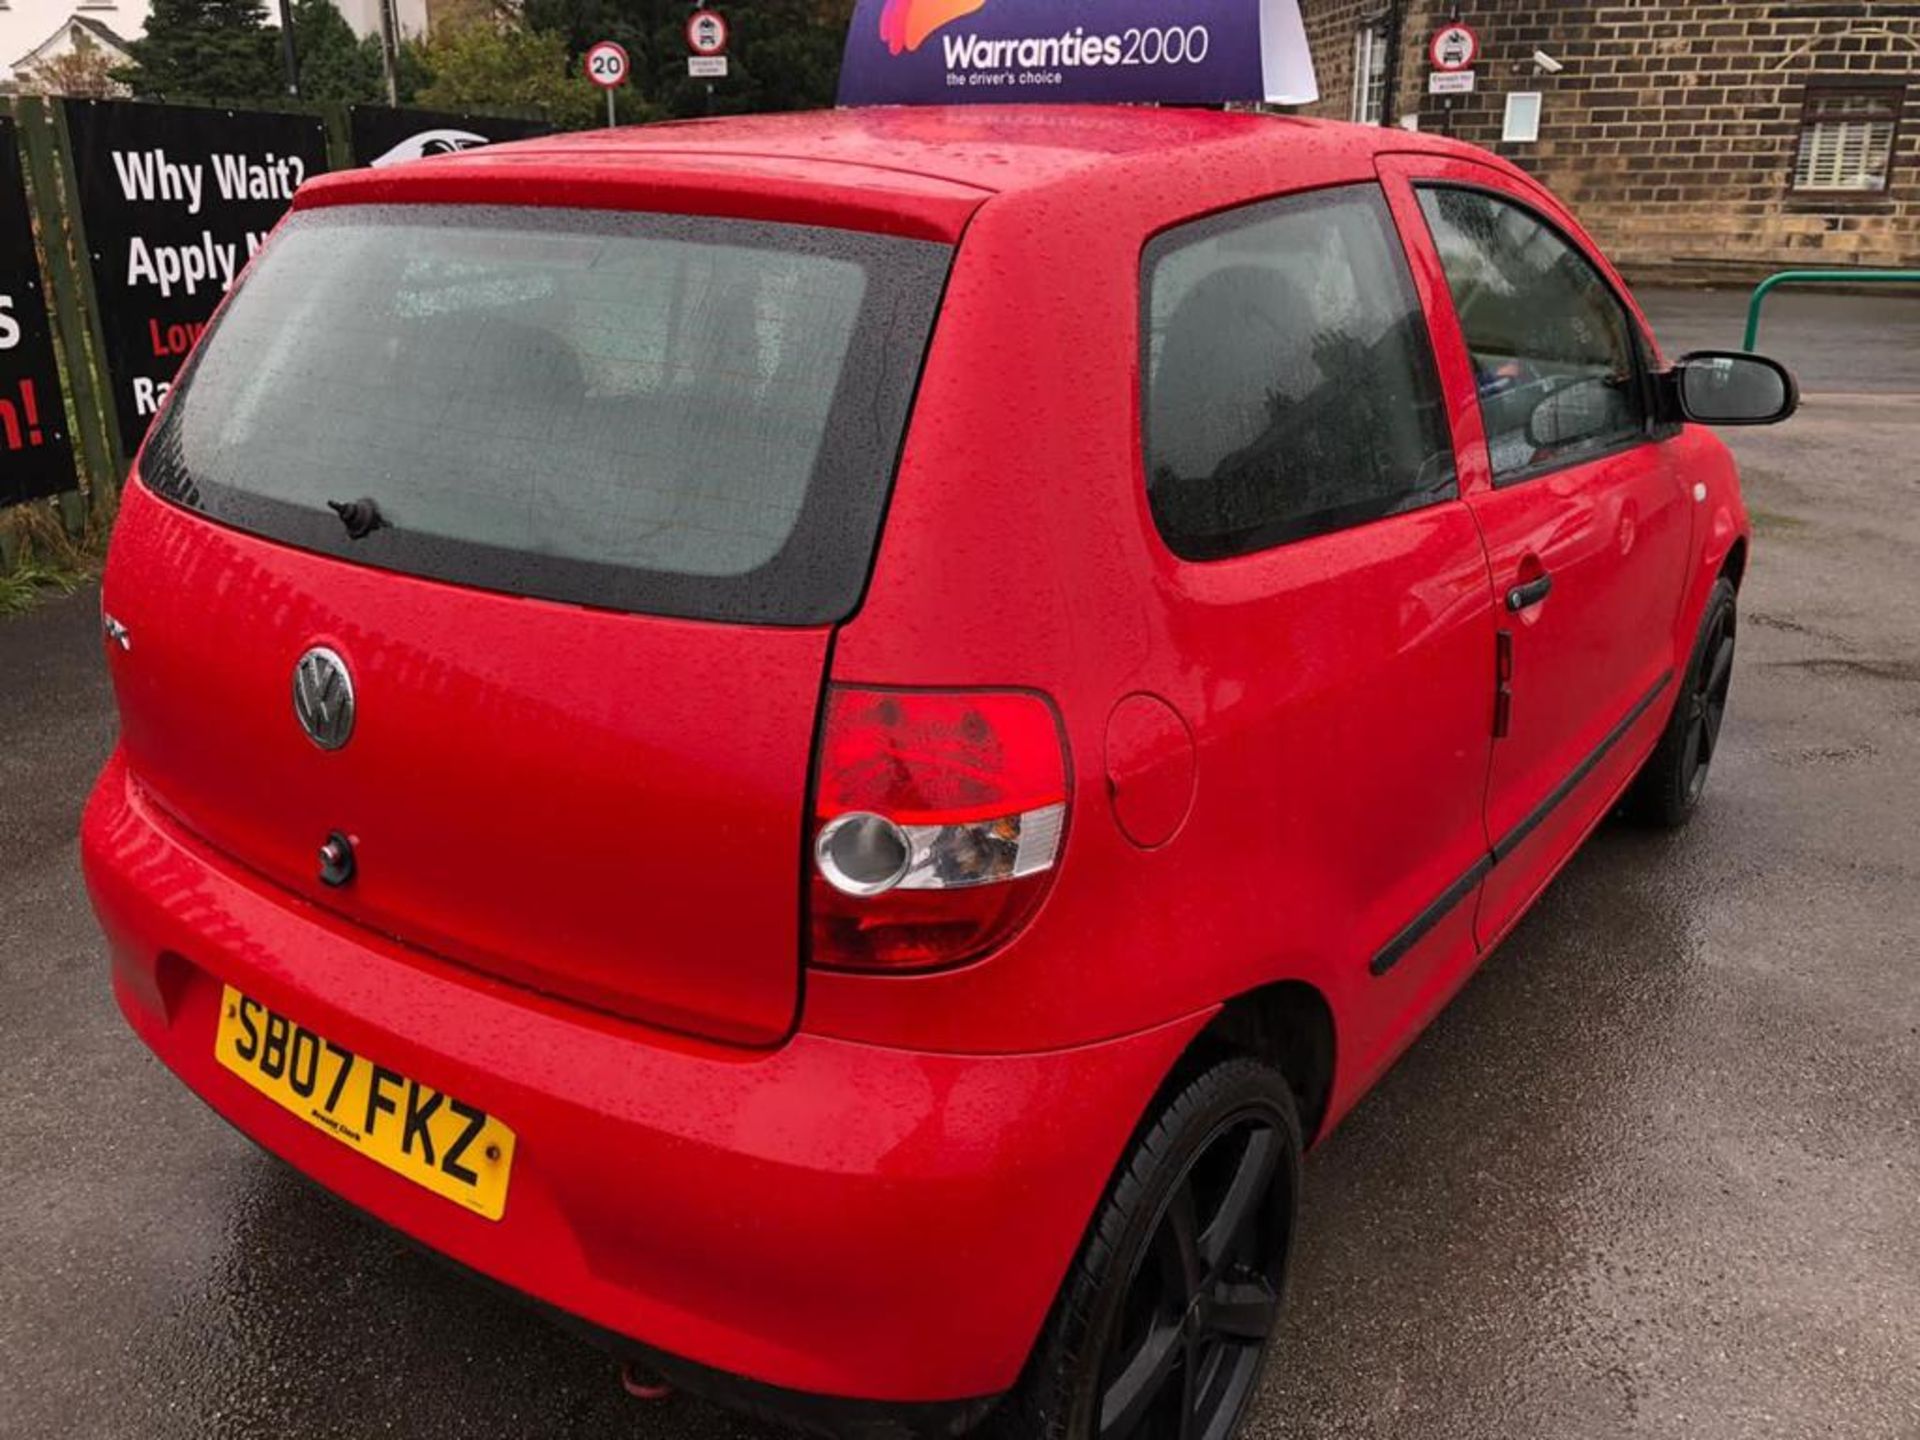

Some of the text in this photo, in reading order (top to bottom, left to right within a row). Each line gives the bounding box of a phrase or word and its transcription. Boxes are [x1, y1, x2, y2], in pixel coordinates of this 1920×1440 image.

[592, 57, 621, 74] 20
[943, 25, 1209, 69] Warranties2000
[946, 69, 1062, 86] the driver's choice
[112, 148, 304, 214] Why Wait?
[127, 230, 236, 297] Apply
[235, 995, 487, 1187] SB07 FKZ
